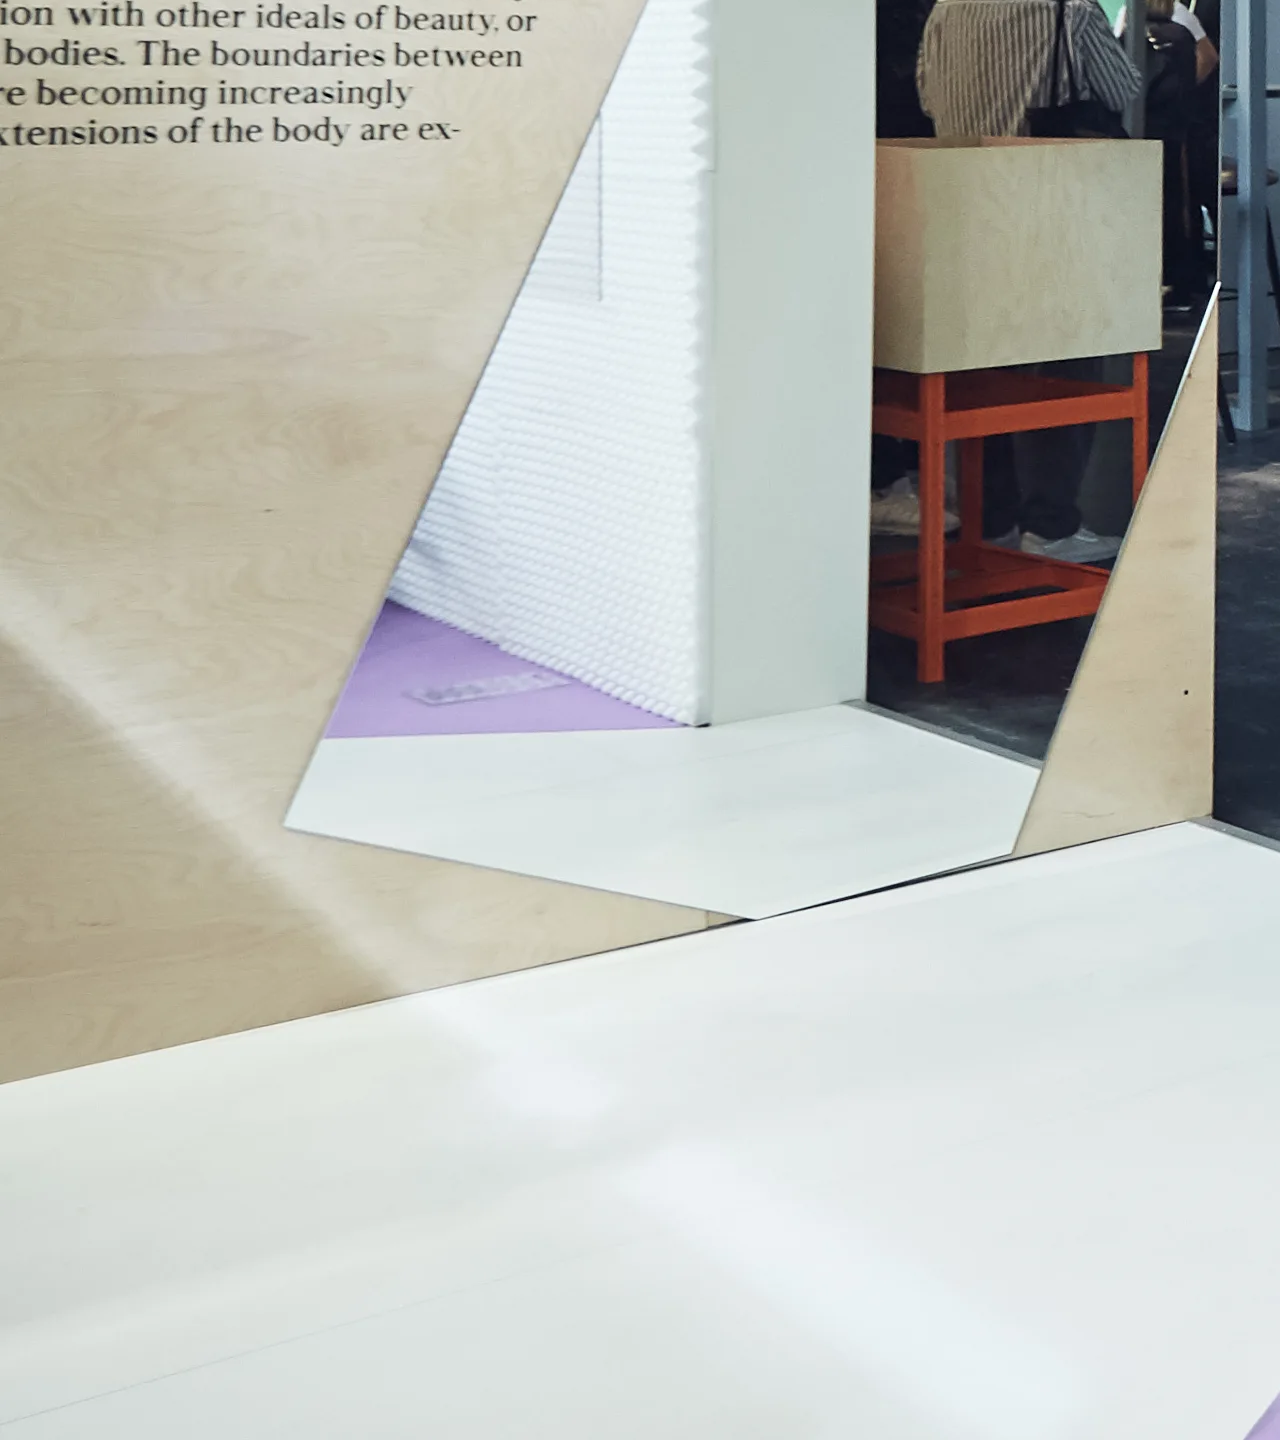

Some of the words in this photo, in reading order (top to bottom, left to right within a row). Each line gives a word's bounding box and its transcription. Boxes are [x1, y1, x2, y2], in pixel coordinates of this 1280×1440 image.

[66, 0, 145, 27] with
[154, 0, 247, 29] other
[255, 2, 347, 30] ideals
[353, 4, 390, 30] of
[393, 4, 500, 37] beauty,
[505, 14, 538, 32] or
[3, 37, 127, 67] bodies.
[135, 39, 202, 67] The
[210, 39, 387, 68] boundaries
[393, 41, 523, 68] between
[35, 77, 209, 112] becoming
[217, 78, 414, 110] increasingly
[166, 116, 206, 144] of
[210, 116, 264, 144] the
[271, 115, 351, 148] body
[359, 122, 410, 142] are
[417, 122, 461, 141] ex-
